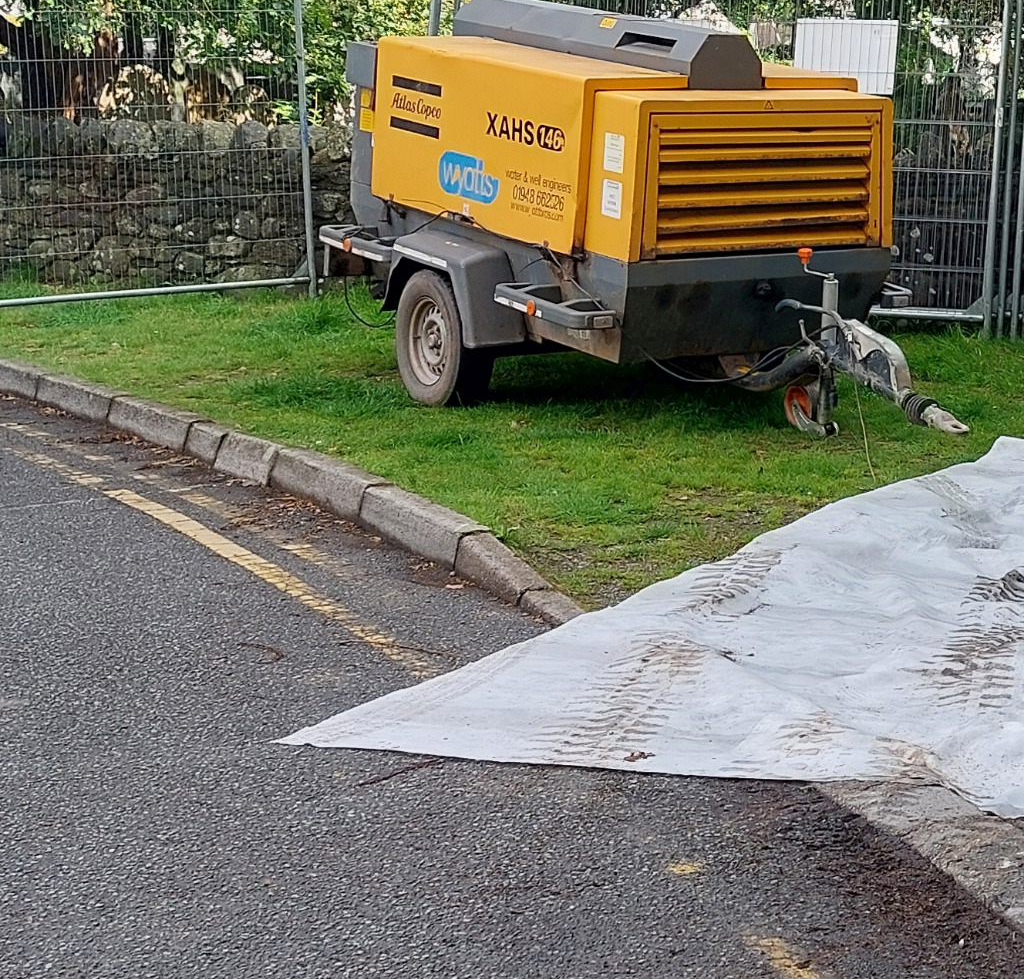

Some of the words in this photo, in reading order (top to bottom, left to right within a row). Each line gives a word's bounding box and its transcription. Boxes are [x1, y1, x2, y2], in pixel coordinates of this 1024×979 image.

[391, 92, 416, 113] Atlas
[416, 98, 442, 120] Copco
[486, 111, 534, 146] XAHS
[442, 157, 494, 198] wyatts
[505, 170, 522, 181] water
[530, 174, 541, 186] well
[543, 178, 571, 194] engineers
